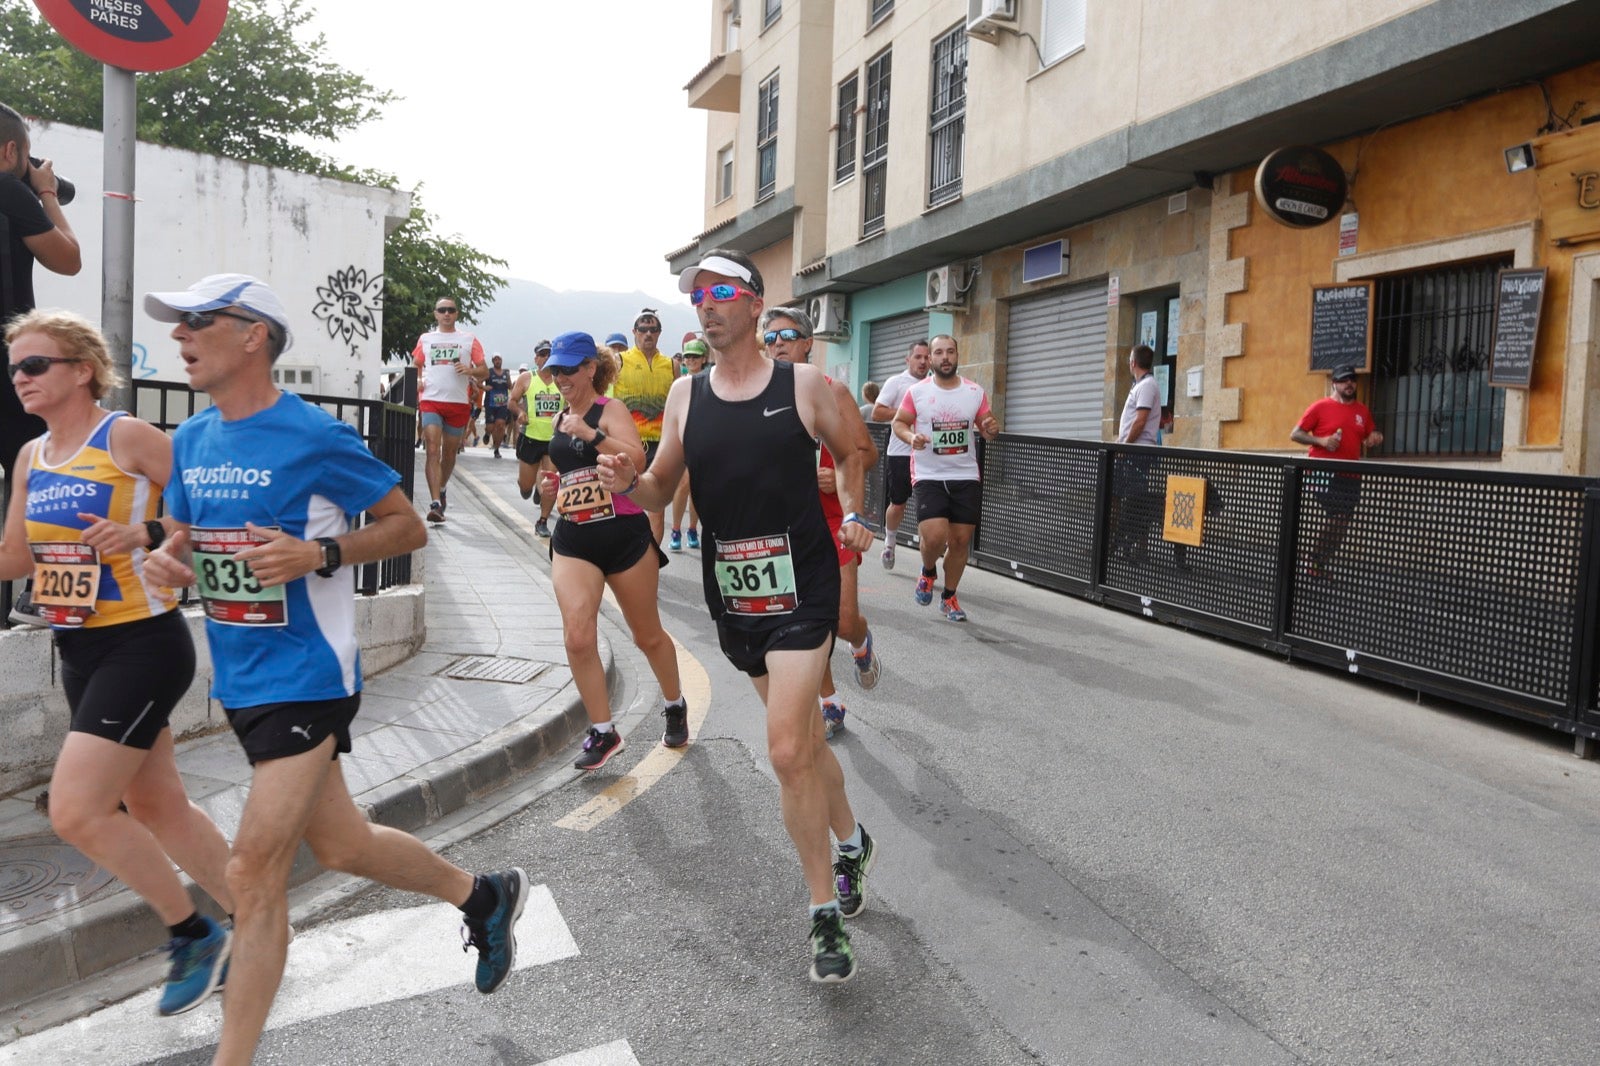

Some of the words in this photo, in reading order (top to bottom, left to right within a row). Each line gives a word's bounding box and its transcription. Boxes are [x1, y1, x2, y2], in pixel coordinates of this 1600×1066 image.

[91, 0, 142, 16] MESES
[90, 9, 138, 30] PARES
[1316, 287, 1366, 302] RACIONES
[435, 349, 454, 358] 217
[537, 401, 560, 410] 1029
[939, 432, 965, 445] 408
[563, 484, 605, 508] 2221
[41, 570, 92, 598] 2205
[726, 561, 778, 591] 361
